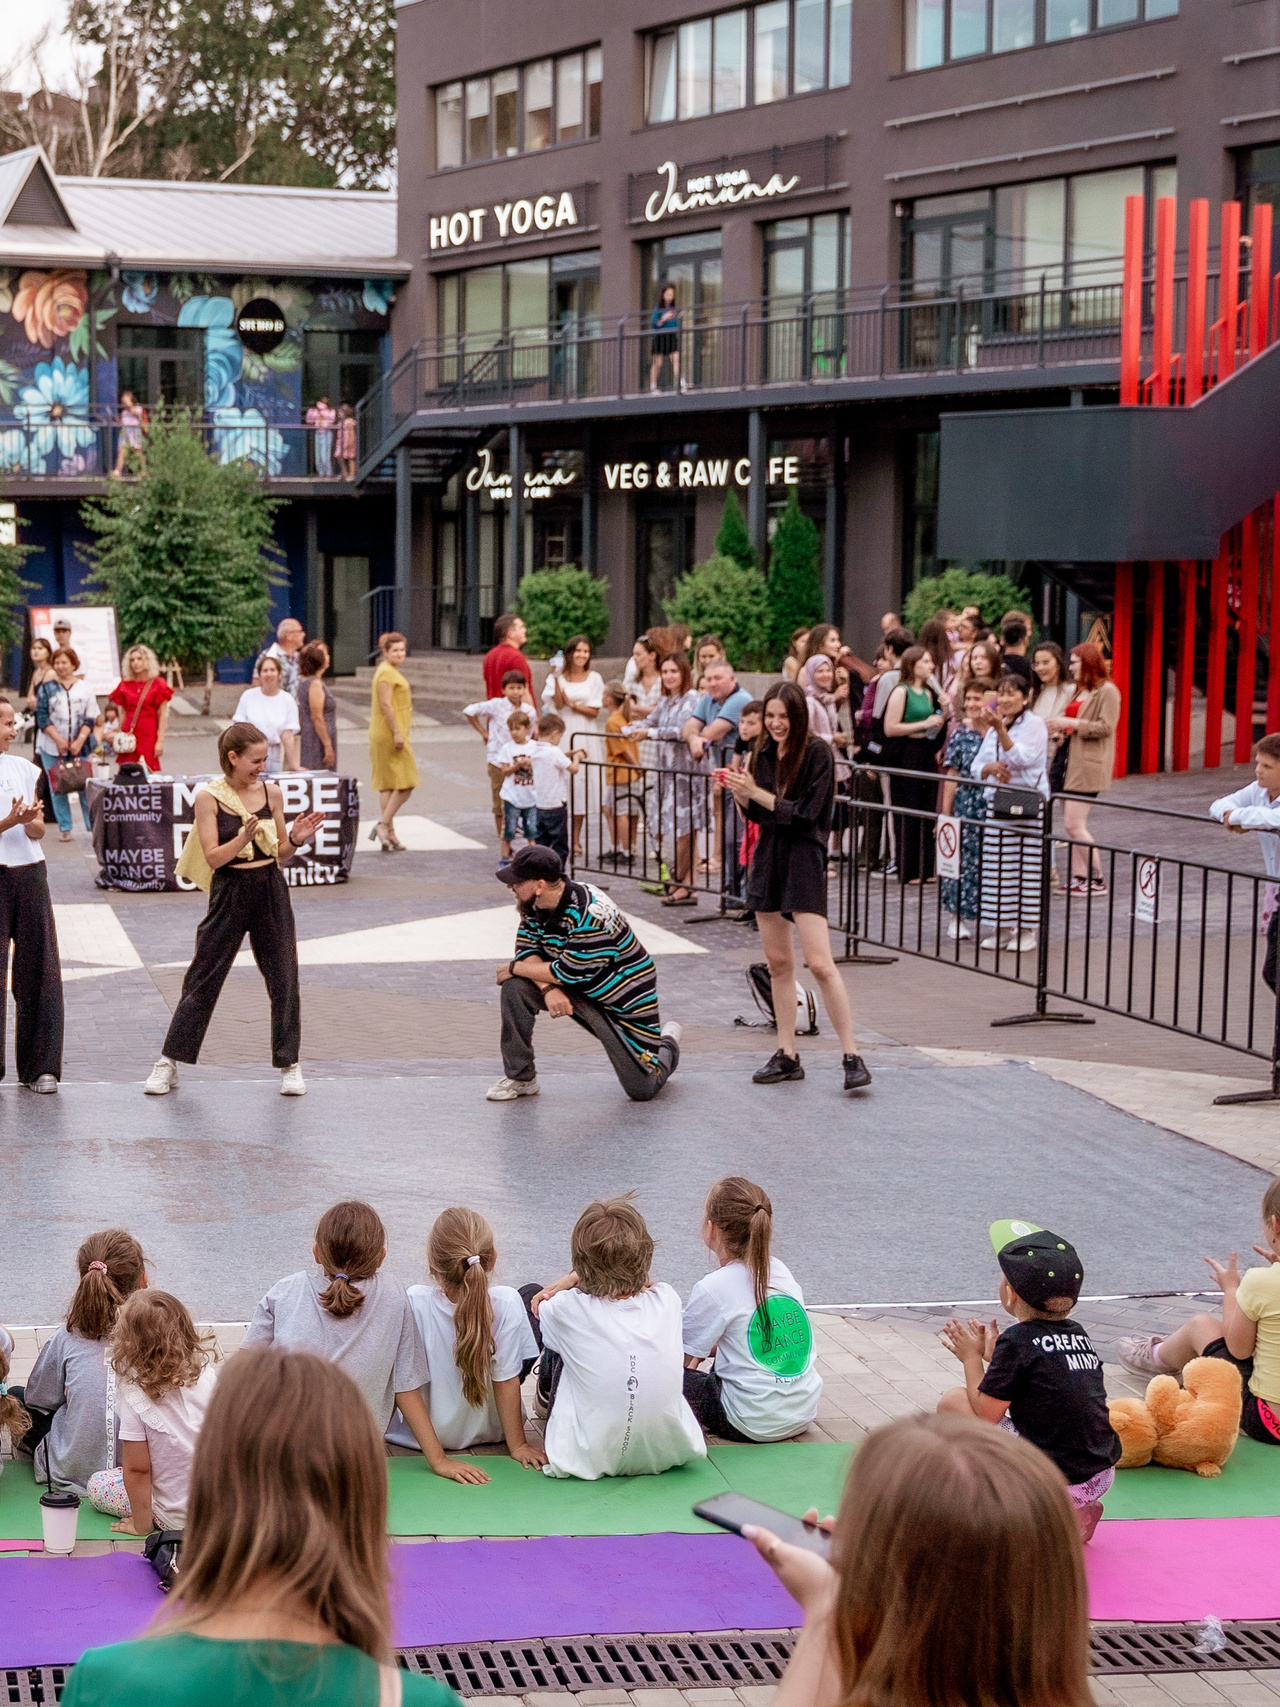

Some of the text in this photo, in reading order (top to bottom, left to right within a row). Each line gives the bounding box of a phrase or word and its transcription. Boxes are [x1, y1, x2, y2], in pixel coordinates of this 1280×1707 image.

[687, 168, 751, 194] HOT YOGA
[430, 192, 578, 250] HOT YOGA
[604, 456, 800, 489] VEG & RAW CFE
[102, 796, 163, 811] DANCE
[103, 811, 163, 824] Community
[105, 848, 165, 864] MAYBE
[107, 864, 166, 879] DANCE
[761, 1328, 806, 1354] DANCE
[107, 1367, 115, 1411] BLACK
